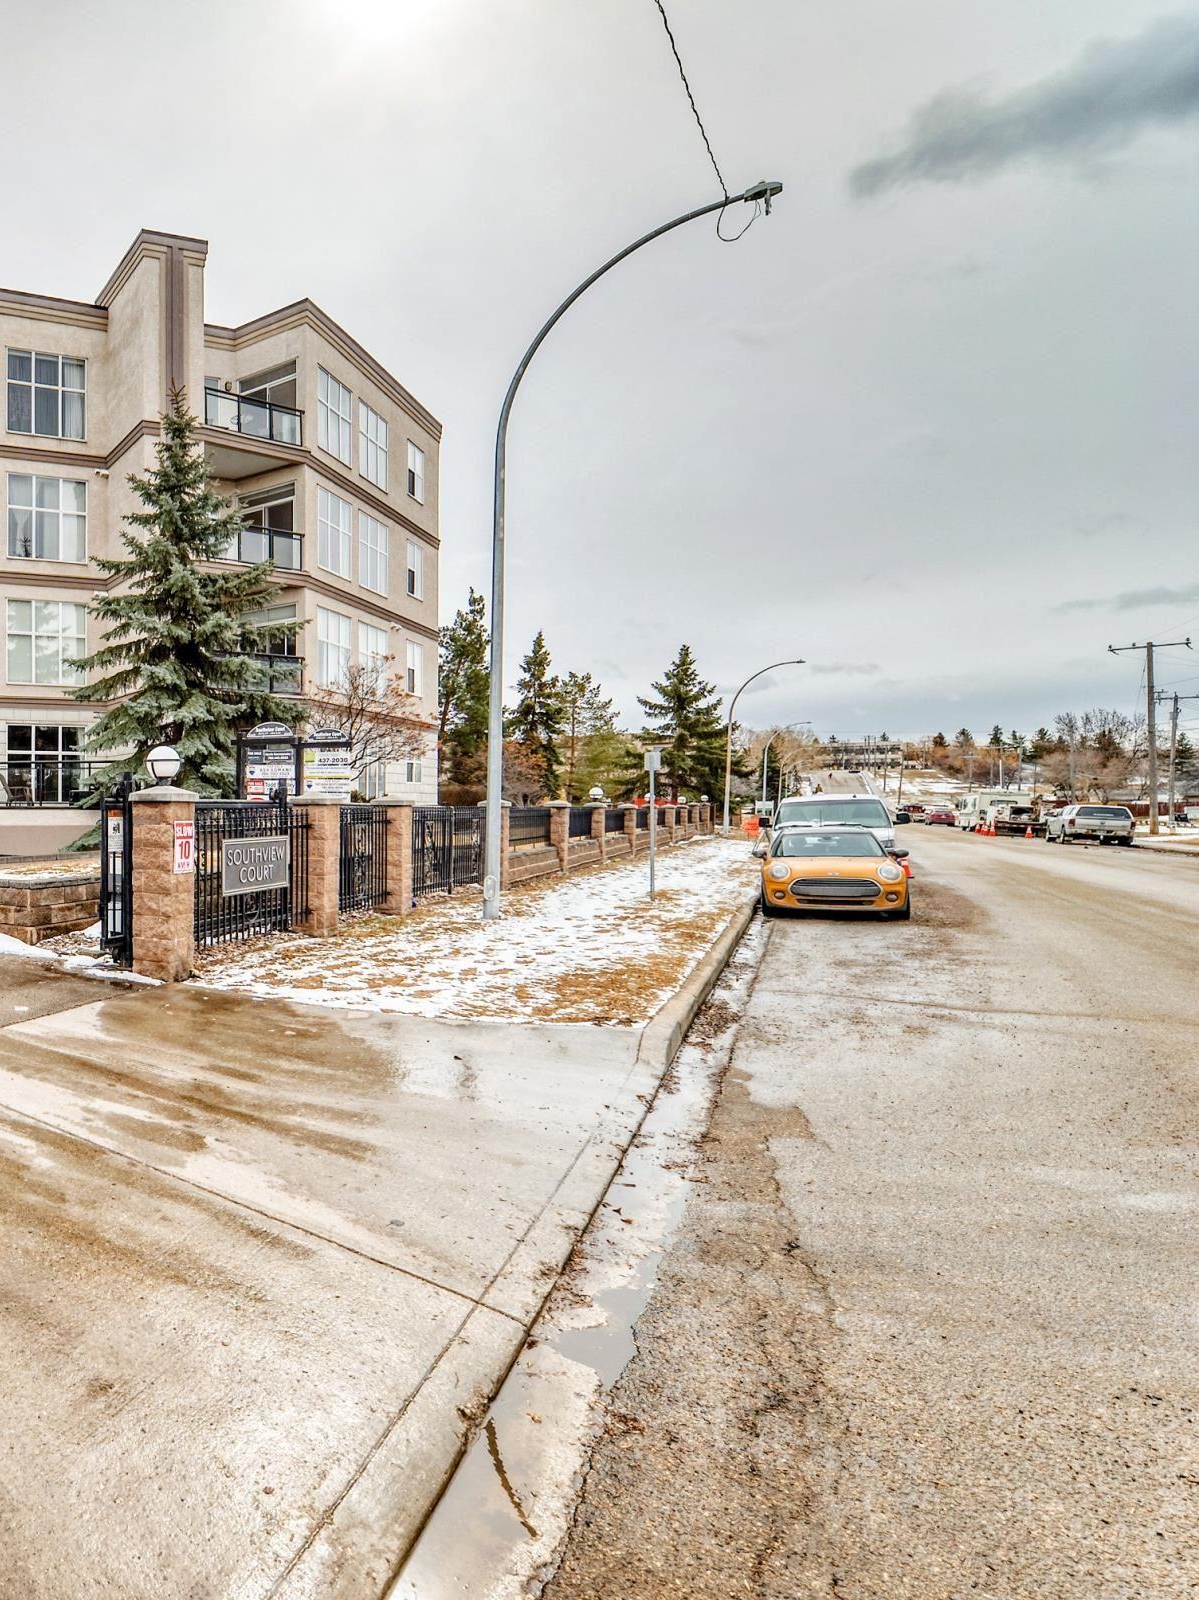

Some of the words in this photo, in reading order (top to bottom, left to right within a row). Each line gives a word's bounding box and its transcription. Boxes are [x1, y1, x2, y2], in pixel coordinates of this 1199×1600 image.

[176, 825, 193, 837] SLOW
[179, 841, 190, 859] 10
[227, 846, 285, 866] SOUTHVIEW
[240, 864, 273, 883] COURT
